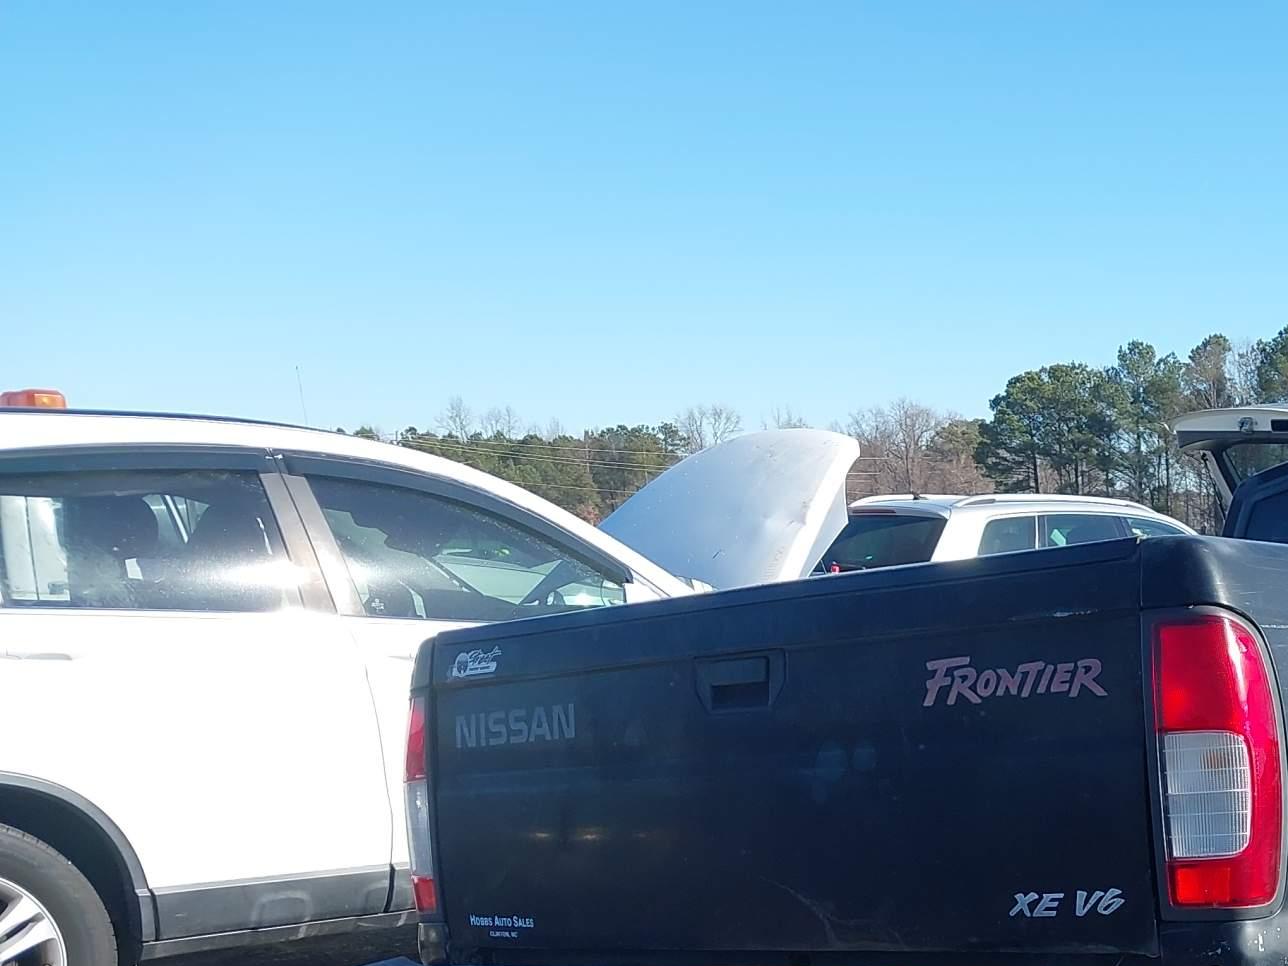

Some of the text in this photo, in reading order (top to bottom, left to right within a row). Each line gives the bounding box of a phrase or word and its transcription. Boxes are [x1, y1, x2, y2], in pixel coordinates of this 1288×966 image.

[923, 656, 1108, 706] FRONTIER
[455, 703, 576, 748] NISSAN
[1009, 888, 1125, 917] XE V6
[494, 915, 512, 927] AUTO
[512, 915, 535, 928] SALES
